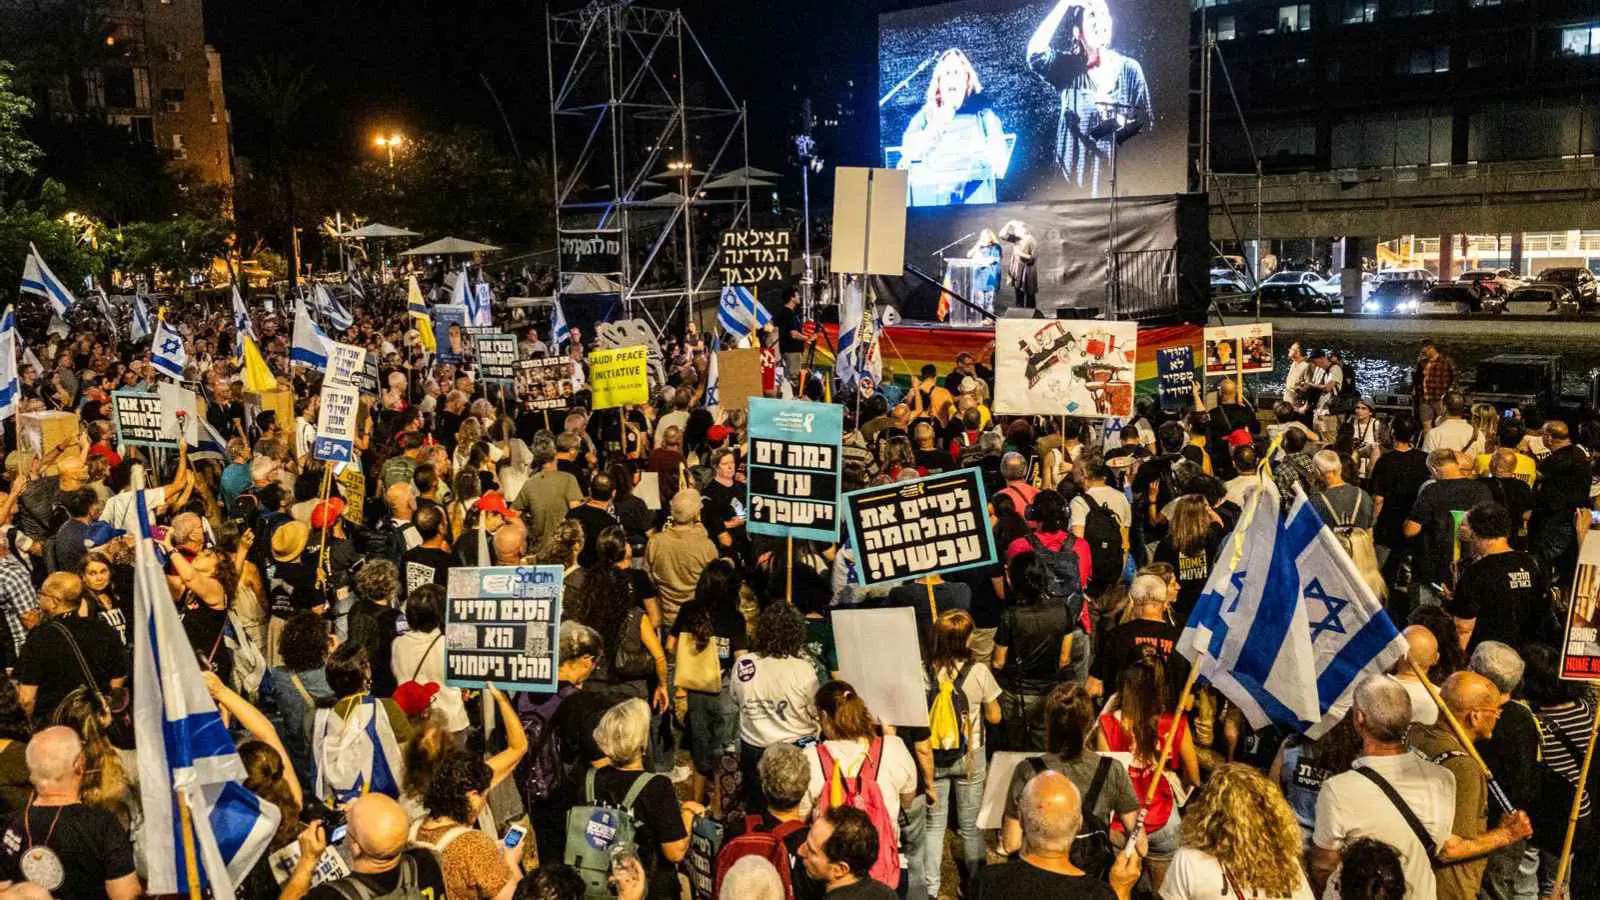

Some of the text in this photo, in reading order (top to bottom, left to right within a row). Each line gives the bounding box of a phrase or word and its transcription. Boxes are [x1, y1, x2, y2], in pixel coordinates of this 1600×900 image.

[725, 247, 789, 264] המדינה
[616, 350, 645, 362] PEACE
[1163, 346, 1189, 359] יהודי
[594, 366, 641, 380] INITIATIVE
[1170, 358, 1184, 371] לא
[1167, 385, 1192, 398] יהודי
[755, 441, 832, 469] כמה דם
[774, 472, 811, 496] עוד
[752, 495, 833, 524] יישפך?
[900, 487, 972, 520] לסיים
[859, 504, 898, 529] את
[863, 511, 977, 551] המלחמה
[867, 534, 981, 580] עכשיו!
[514, 566, 553, 584] Salam
[454, 599, 550, 620] הסכם מדיני
[484, 627, 514, 648] הוא
[1570, 627, 1597, 641] BRING
[1567, 641, 1584, 656] HIM
[449, 653, 551, 681] מהלך ביטחוני
[1565, 656, 1589, 671] HOME
